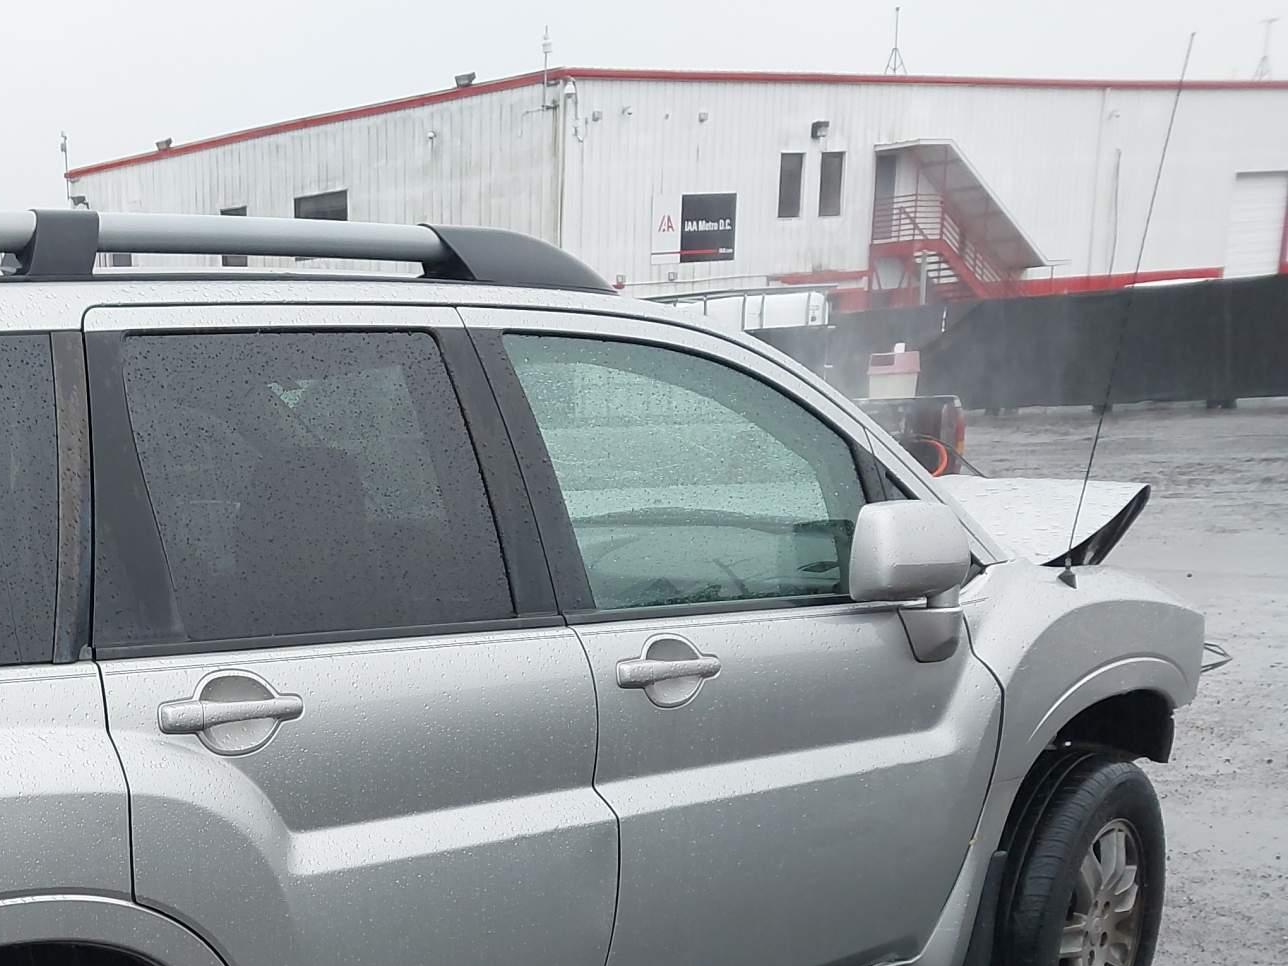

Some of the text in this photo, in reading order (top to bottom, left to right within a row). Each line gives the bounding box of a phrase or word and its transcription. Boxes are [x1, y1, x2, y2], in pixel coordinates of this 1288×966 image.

[684, 219, 732, 232] IAA Metro D.C.
